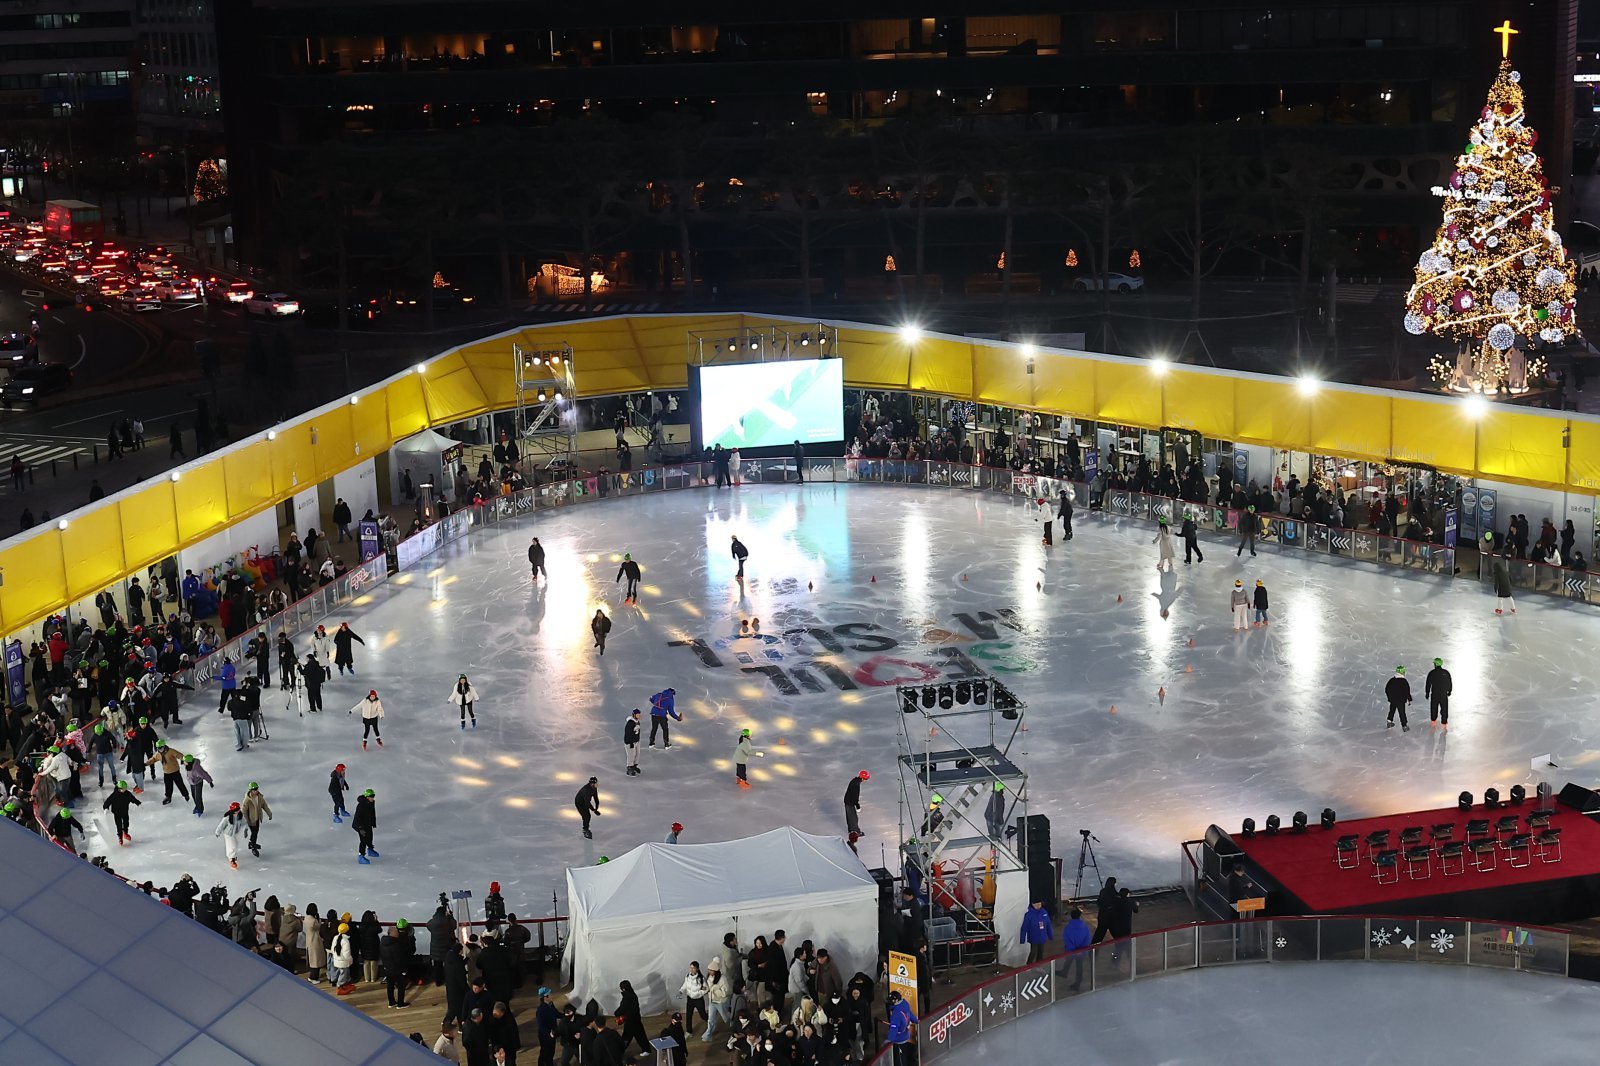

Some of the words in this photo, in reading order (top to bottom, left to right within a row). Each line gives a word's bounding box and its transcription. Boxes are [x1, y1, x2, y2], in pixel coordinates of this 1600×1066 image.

[1430, 186, 1463, 201] Merry
[1464, 189, 1513, 203] Christmas
[900, 965, 906, 975] 2
[894, 976, 912, 986] GATE
[930, 1003, 967, 1043] 땡겨요
